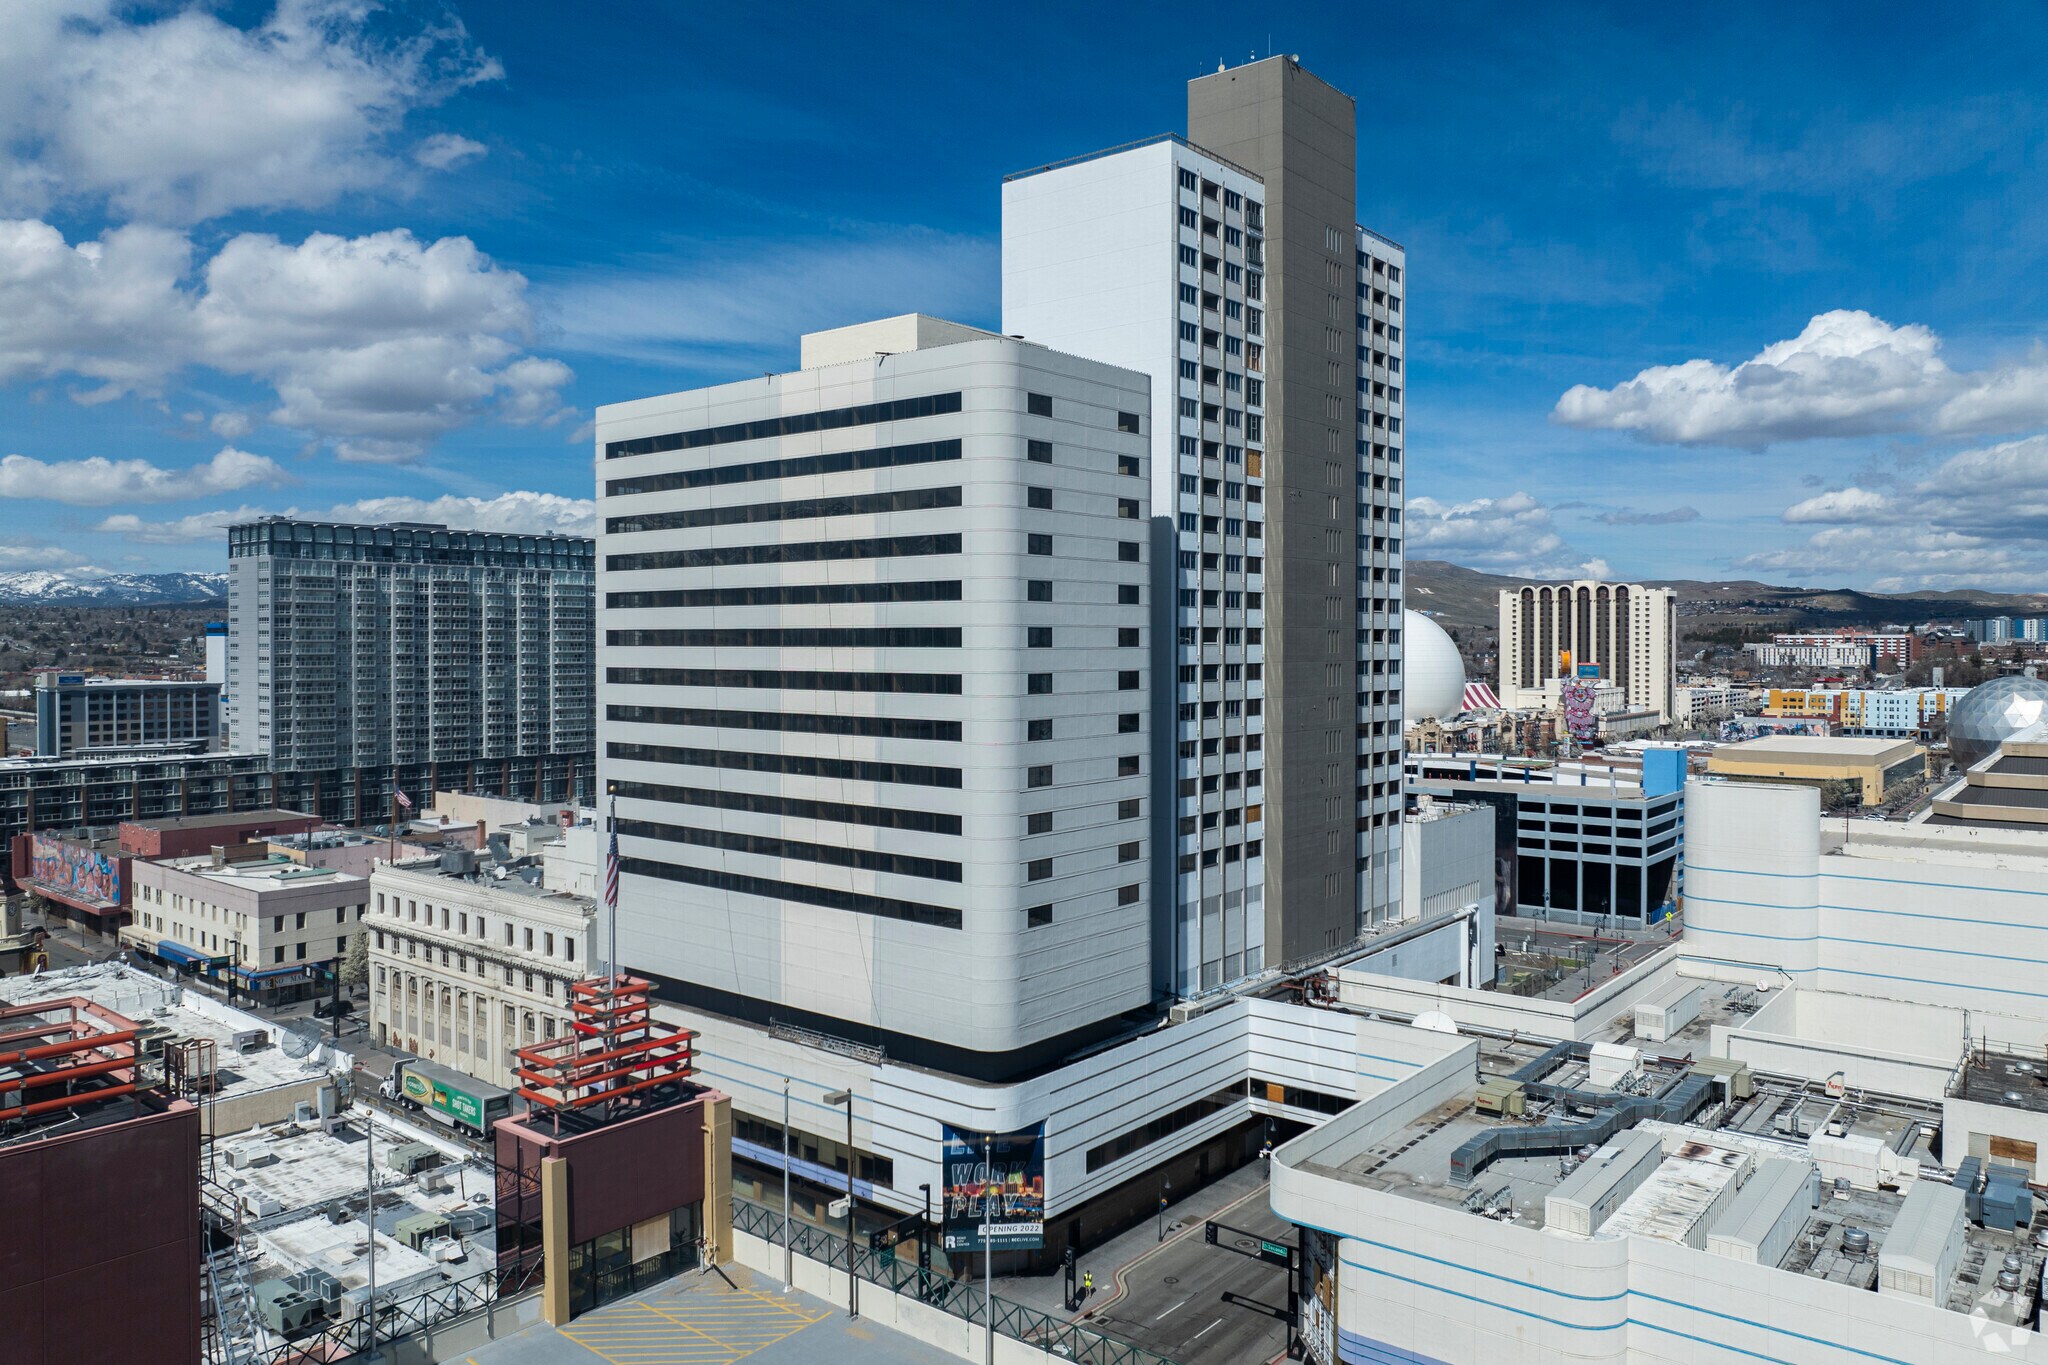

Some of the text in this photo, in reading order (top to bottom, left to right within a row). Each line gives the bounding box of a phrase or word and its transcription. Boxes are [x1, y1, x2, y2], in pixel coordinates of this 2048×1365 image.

[951, 1132, 1011, 1155] LIVE
[952, 1162, 1026, 1186] WORK
[951, 1193, 1020, 1219] PLAY
[982, 1225, 1018, 1233] OPENING
